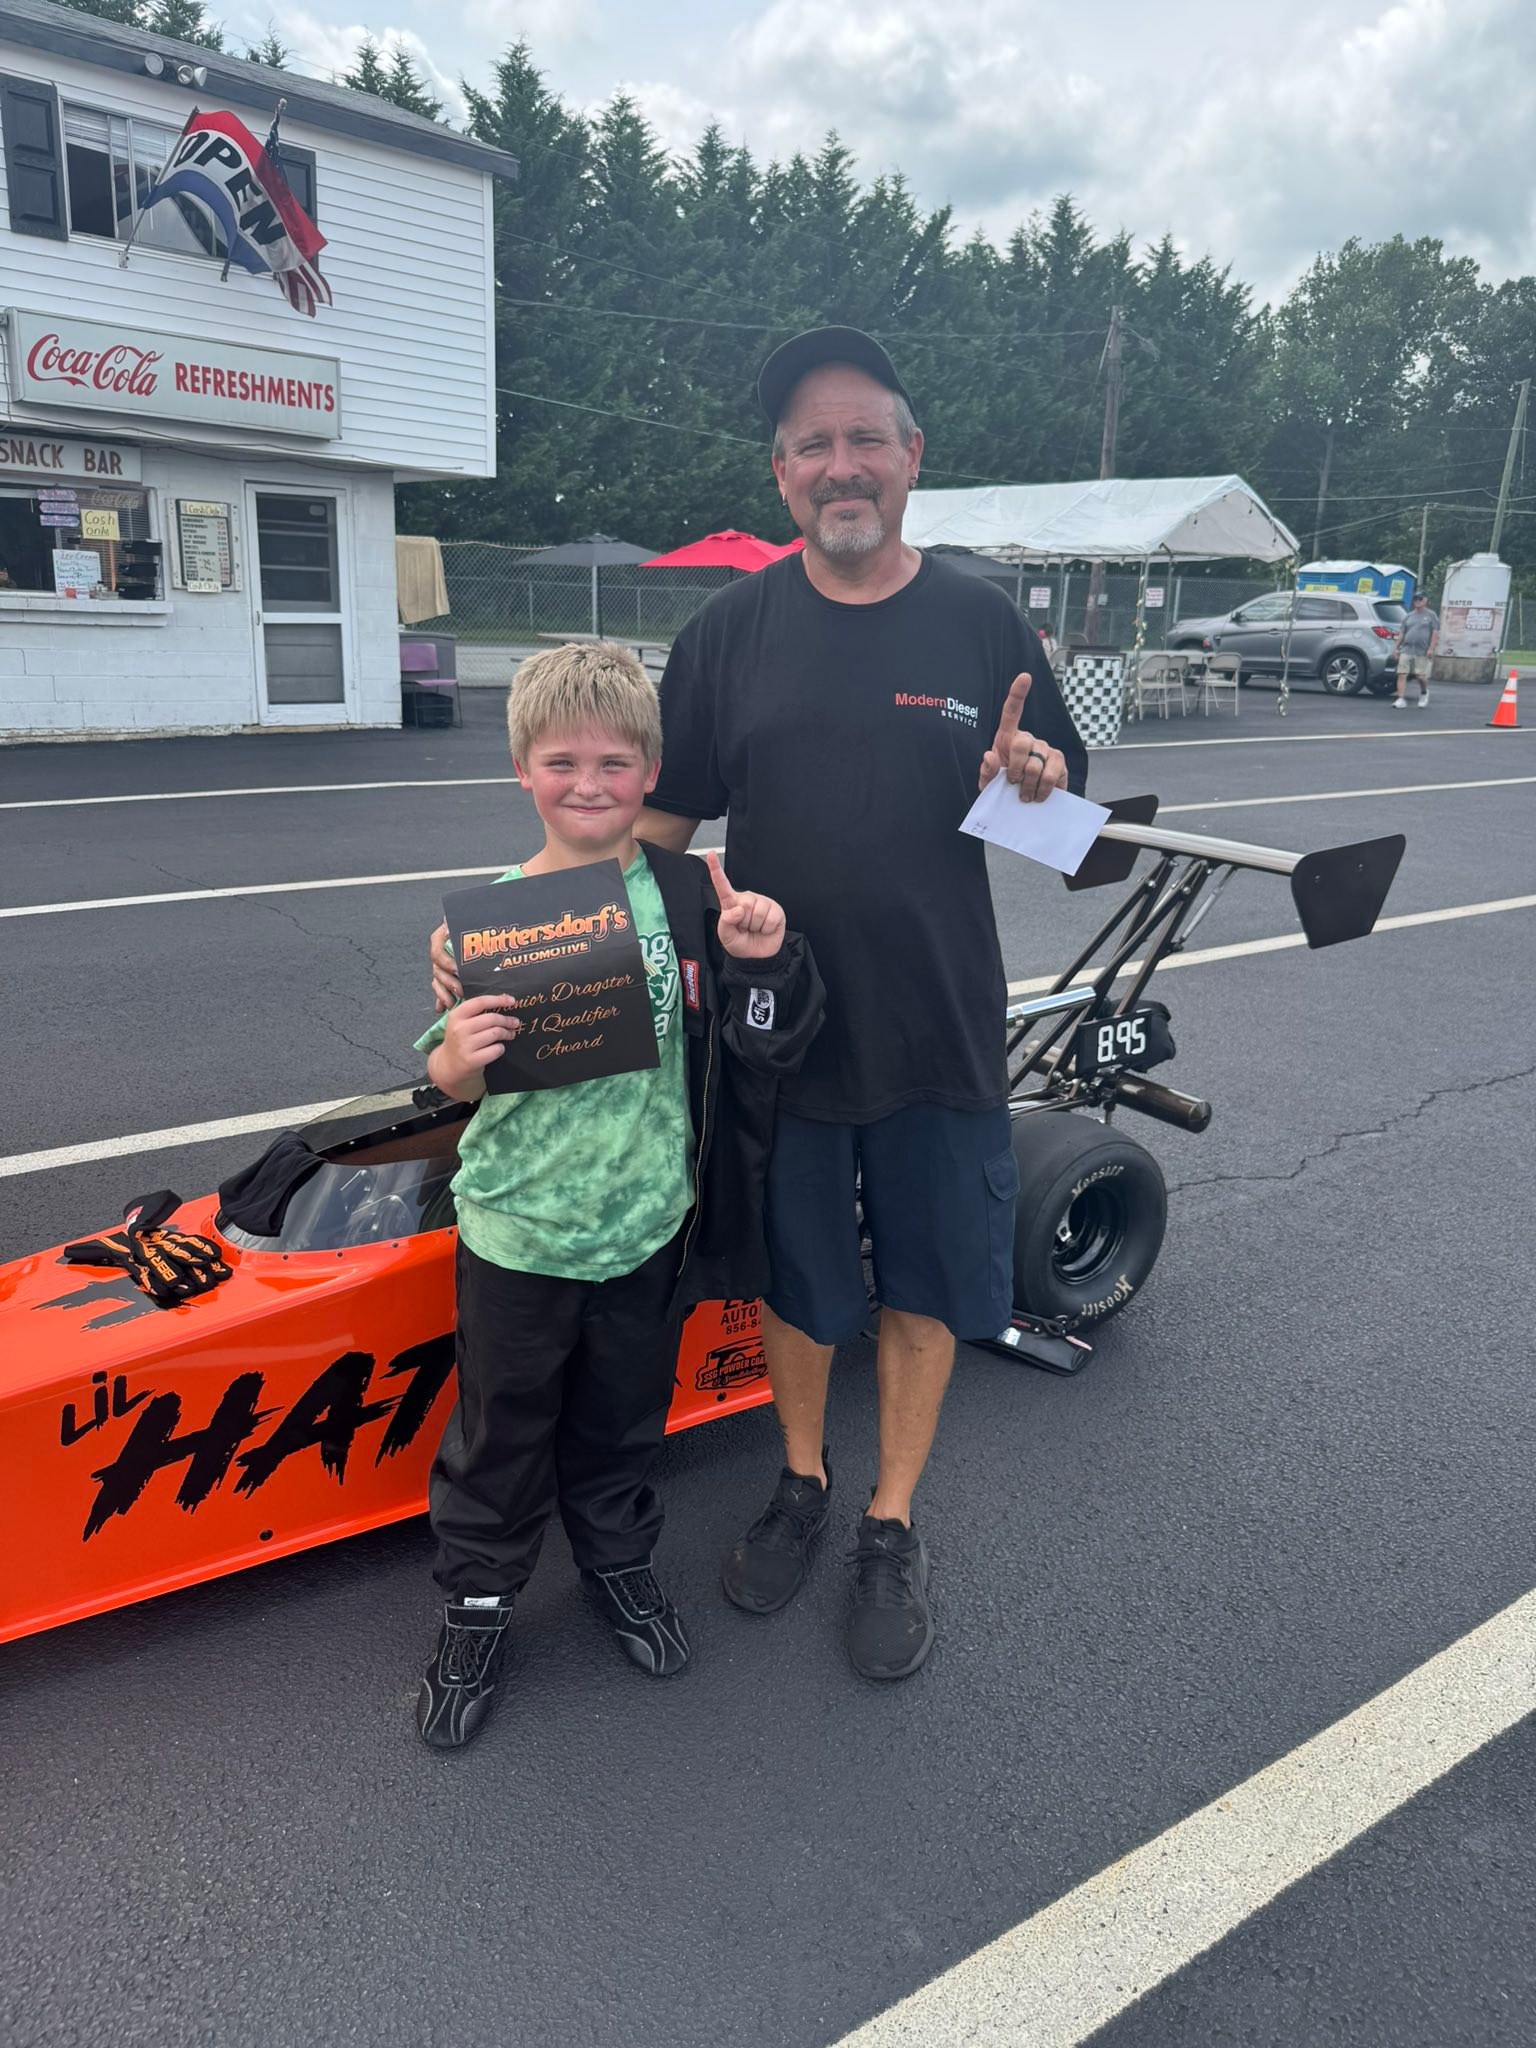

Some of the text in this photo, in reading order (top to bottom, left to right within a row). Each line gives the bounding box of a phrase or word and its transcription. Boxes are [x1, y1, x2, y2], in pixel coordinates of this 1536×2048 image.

[173, 131, 287, 245] OPEN
[27, 333, 335, 412] Coca-Cola REFRESHMENTS
[0, 438, 123, 475] SNACK BAR
[895, 693, 979, 719] ModernDiesel
[941, 710, 977, 728] SERVICE
[462, 902, 630, 963] Blittersdorf's
[502, 941, 589, 968] AUTOMOTIVE
[551, 974, 635, 1002] Dragster
[541, 1006, 621, 1033] Qualifier
[536, 1033, 605, 1060] Award
[1097, 1017, 1146, 1063] 8.95
[725, 1319, 761, 1335] 856-8
